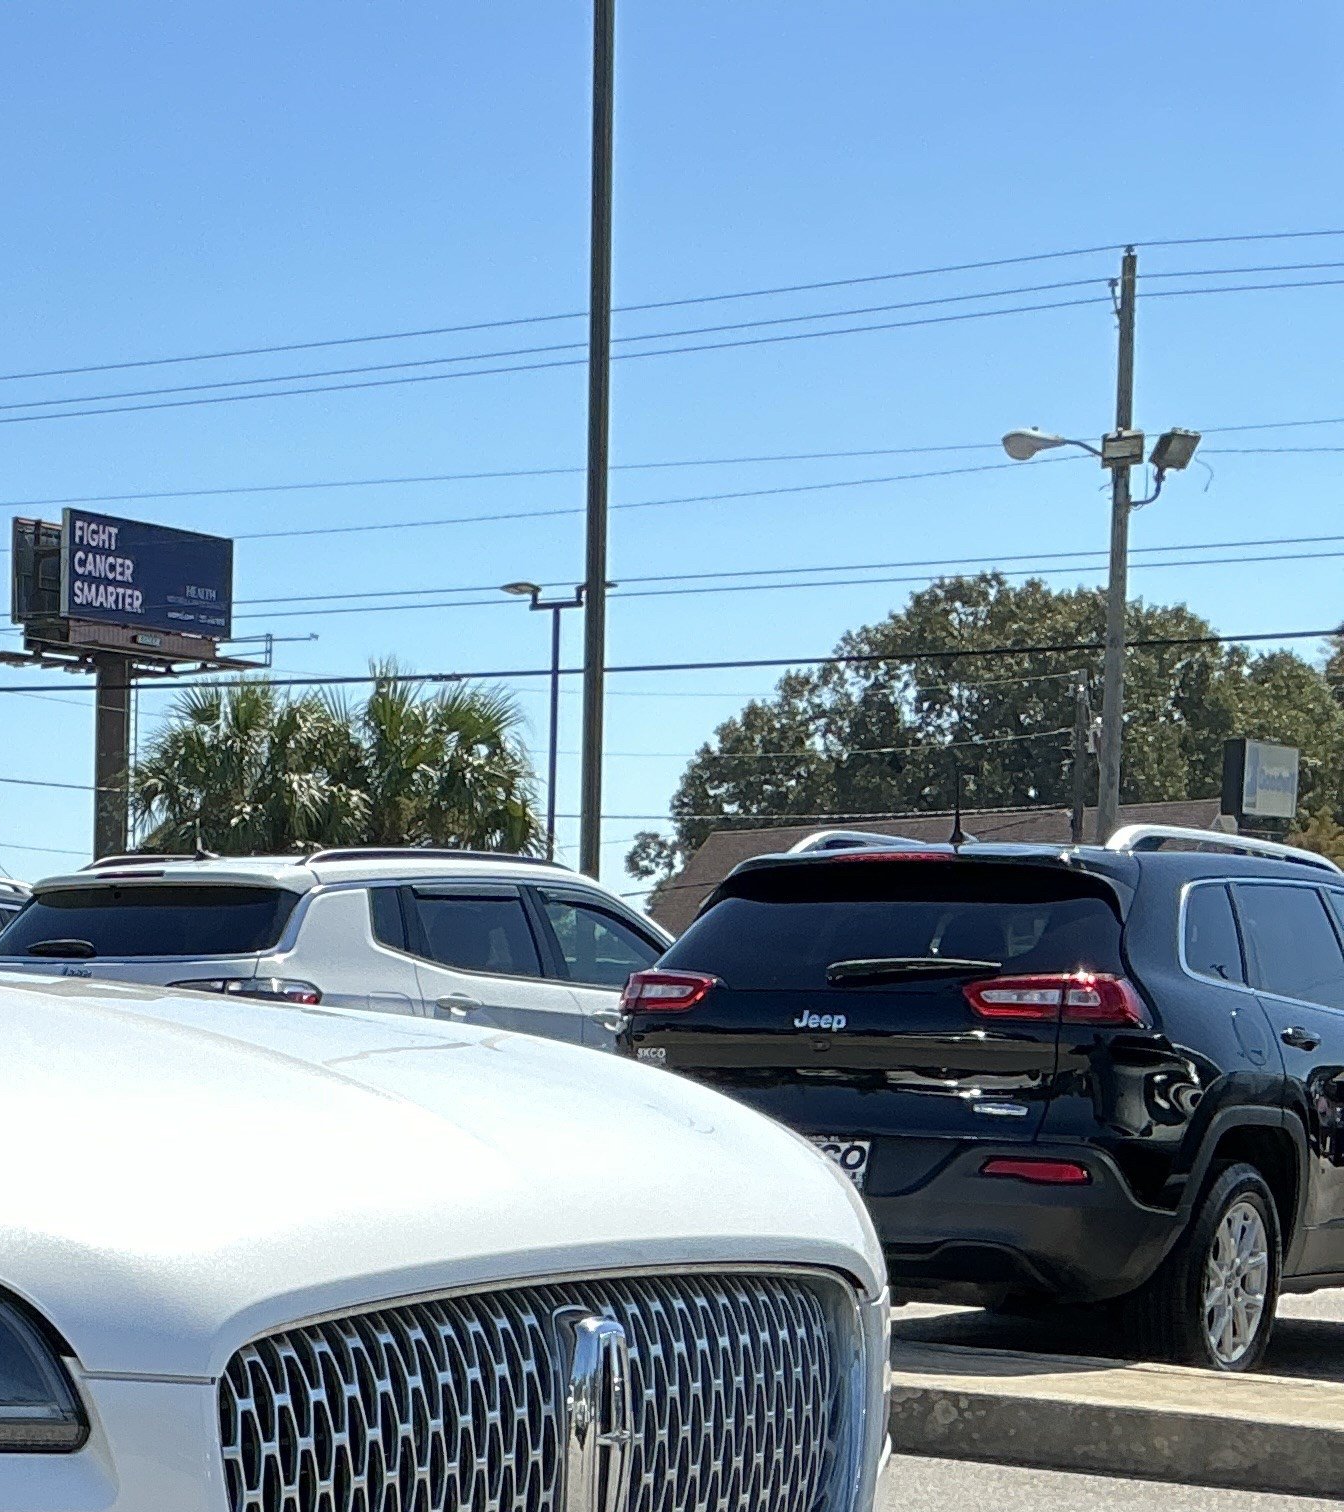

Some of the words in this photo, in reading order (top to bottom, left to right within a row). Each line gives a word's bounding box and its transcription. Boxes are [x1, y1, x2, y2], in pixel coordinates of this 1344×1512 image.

[75, 520, 118, 550] FIGHT
[74, 551, 134, 583] CANCER
[794, 1010, 847, 1032] Jeep
[637, 1047, 666, 1059] SKCO
[816, 1143, 867, 1171] CO
